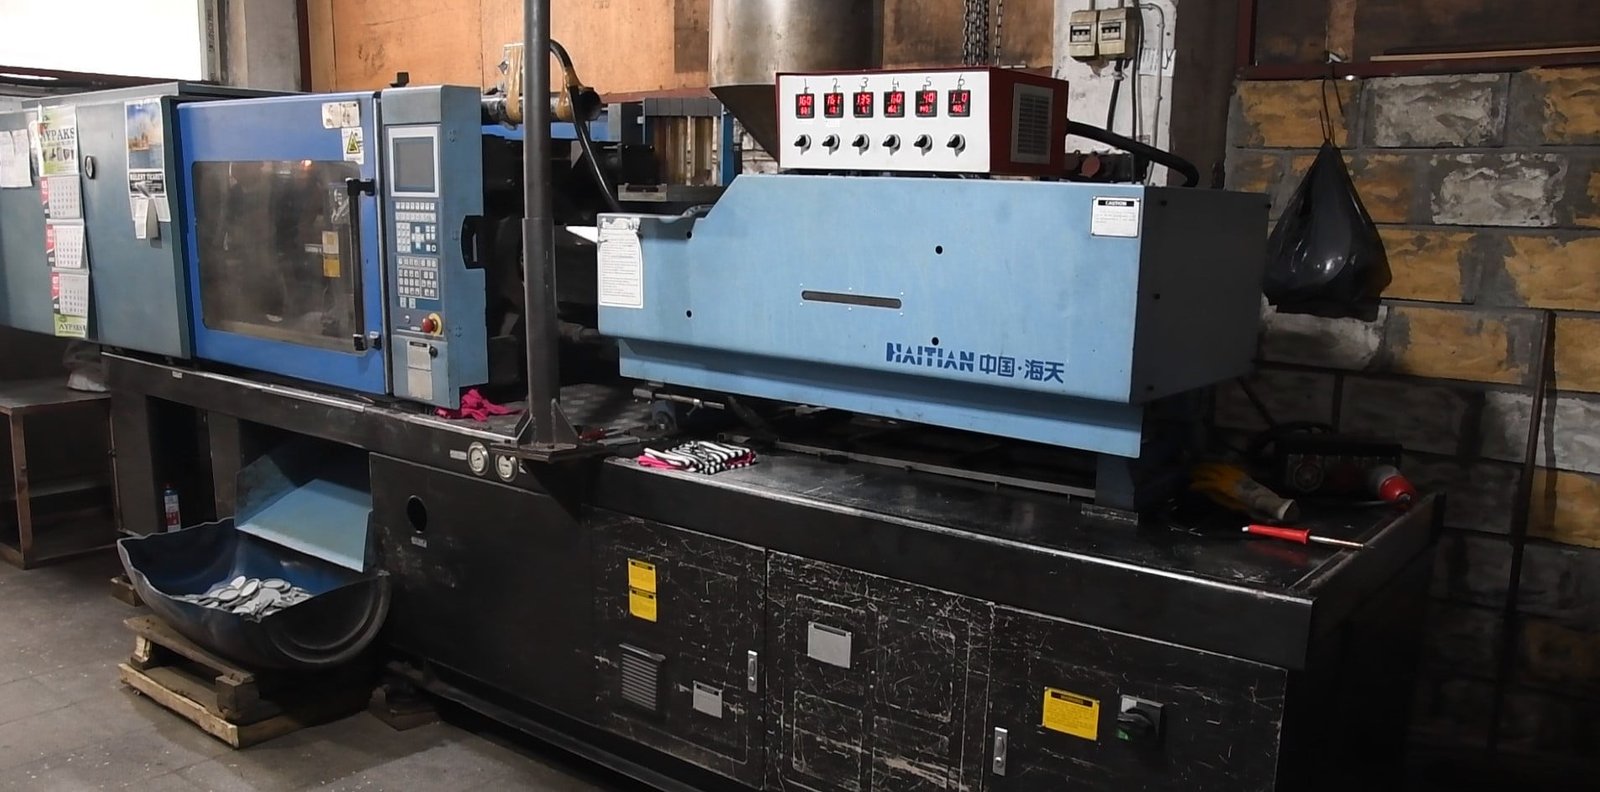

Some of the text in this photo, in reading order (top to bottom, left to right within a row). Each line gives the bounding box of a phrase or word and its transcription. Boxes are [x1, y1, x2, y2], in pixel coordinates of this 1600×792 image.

[860, 77, 869, 87] 3
[958, 74, 965, 86] 6
[886, 342, 975, 372] HAITIAN
